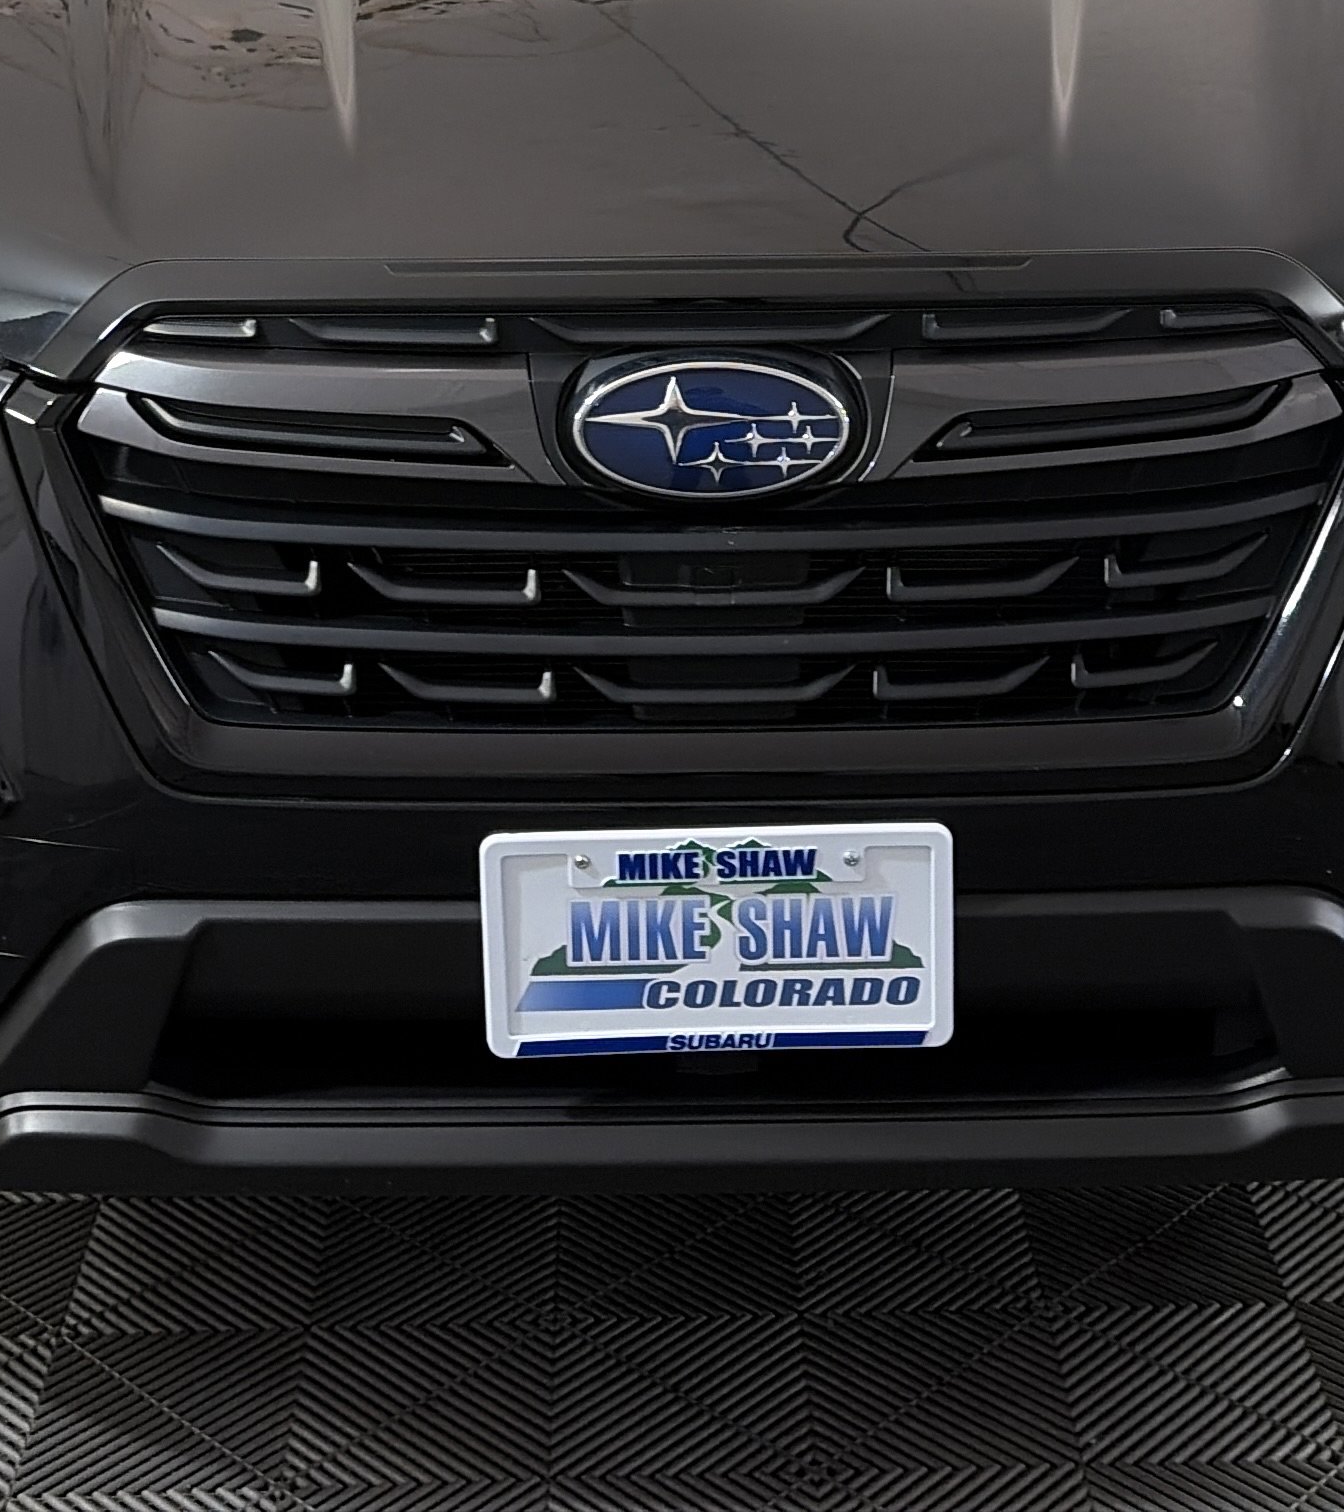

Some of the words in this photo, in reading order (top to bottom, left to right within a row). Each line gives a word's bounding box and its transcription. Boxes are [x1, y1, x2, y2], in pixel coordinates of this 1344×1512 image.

[618, 852, 700, 880] MIKE
[716, 848, 816, 878] SHAW
[570, 899, 706, 962] MIKE
[737, 896, 894, 962] SHAW
[646, 976, 921, 1009] COLORADO
[669, 1034, 772, 1050] SUBARU
